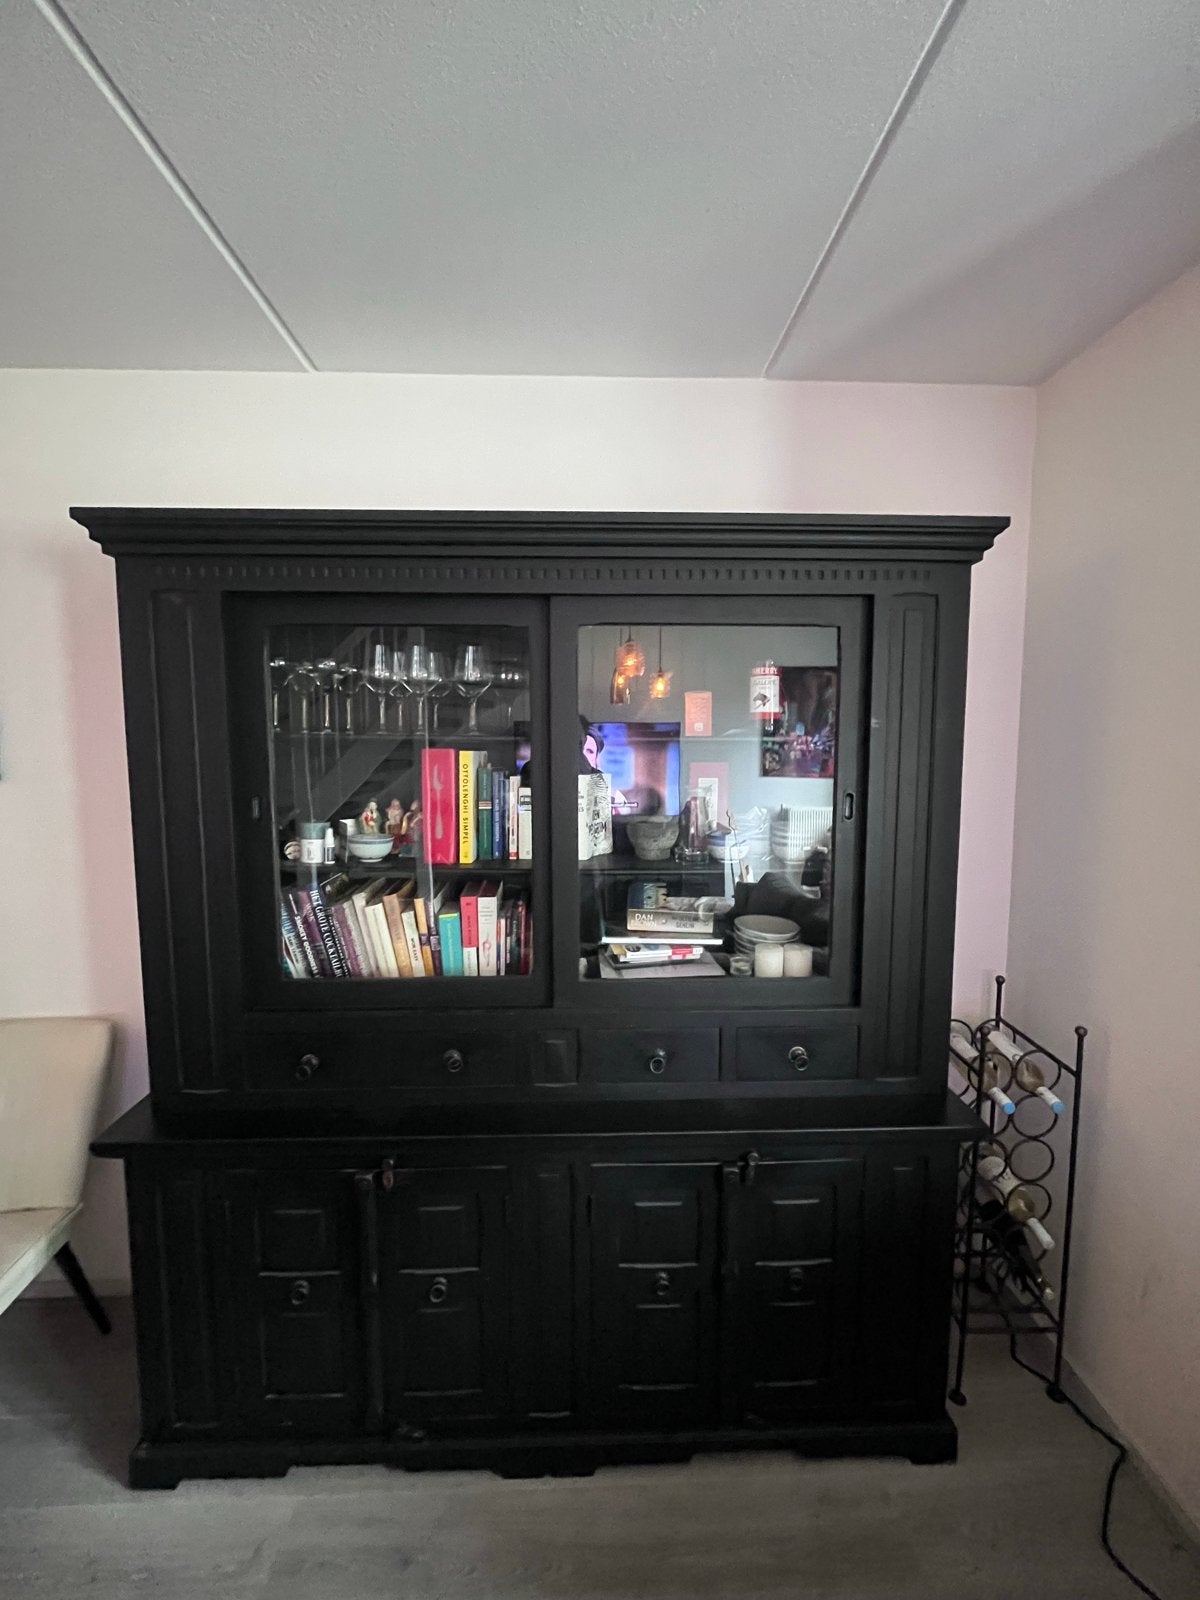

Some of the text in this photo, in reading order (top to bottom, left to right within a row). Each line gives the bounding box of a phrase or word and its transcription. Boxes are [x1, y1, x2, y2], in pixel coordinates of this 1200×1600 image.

[310, 890, 323, 907] HET
[315, 906, 332, 933] GROTE
[635, 913, 654, 921] DAN
[295, 916, 307, 940] SMOKEY
